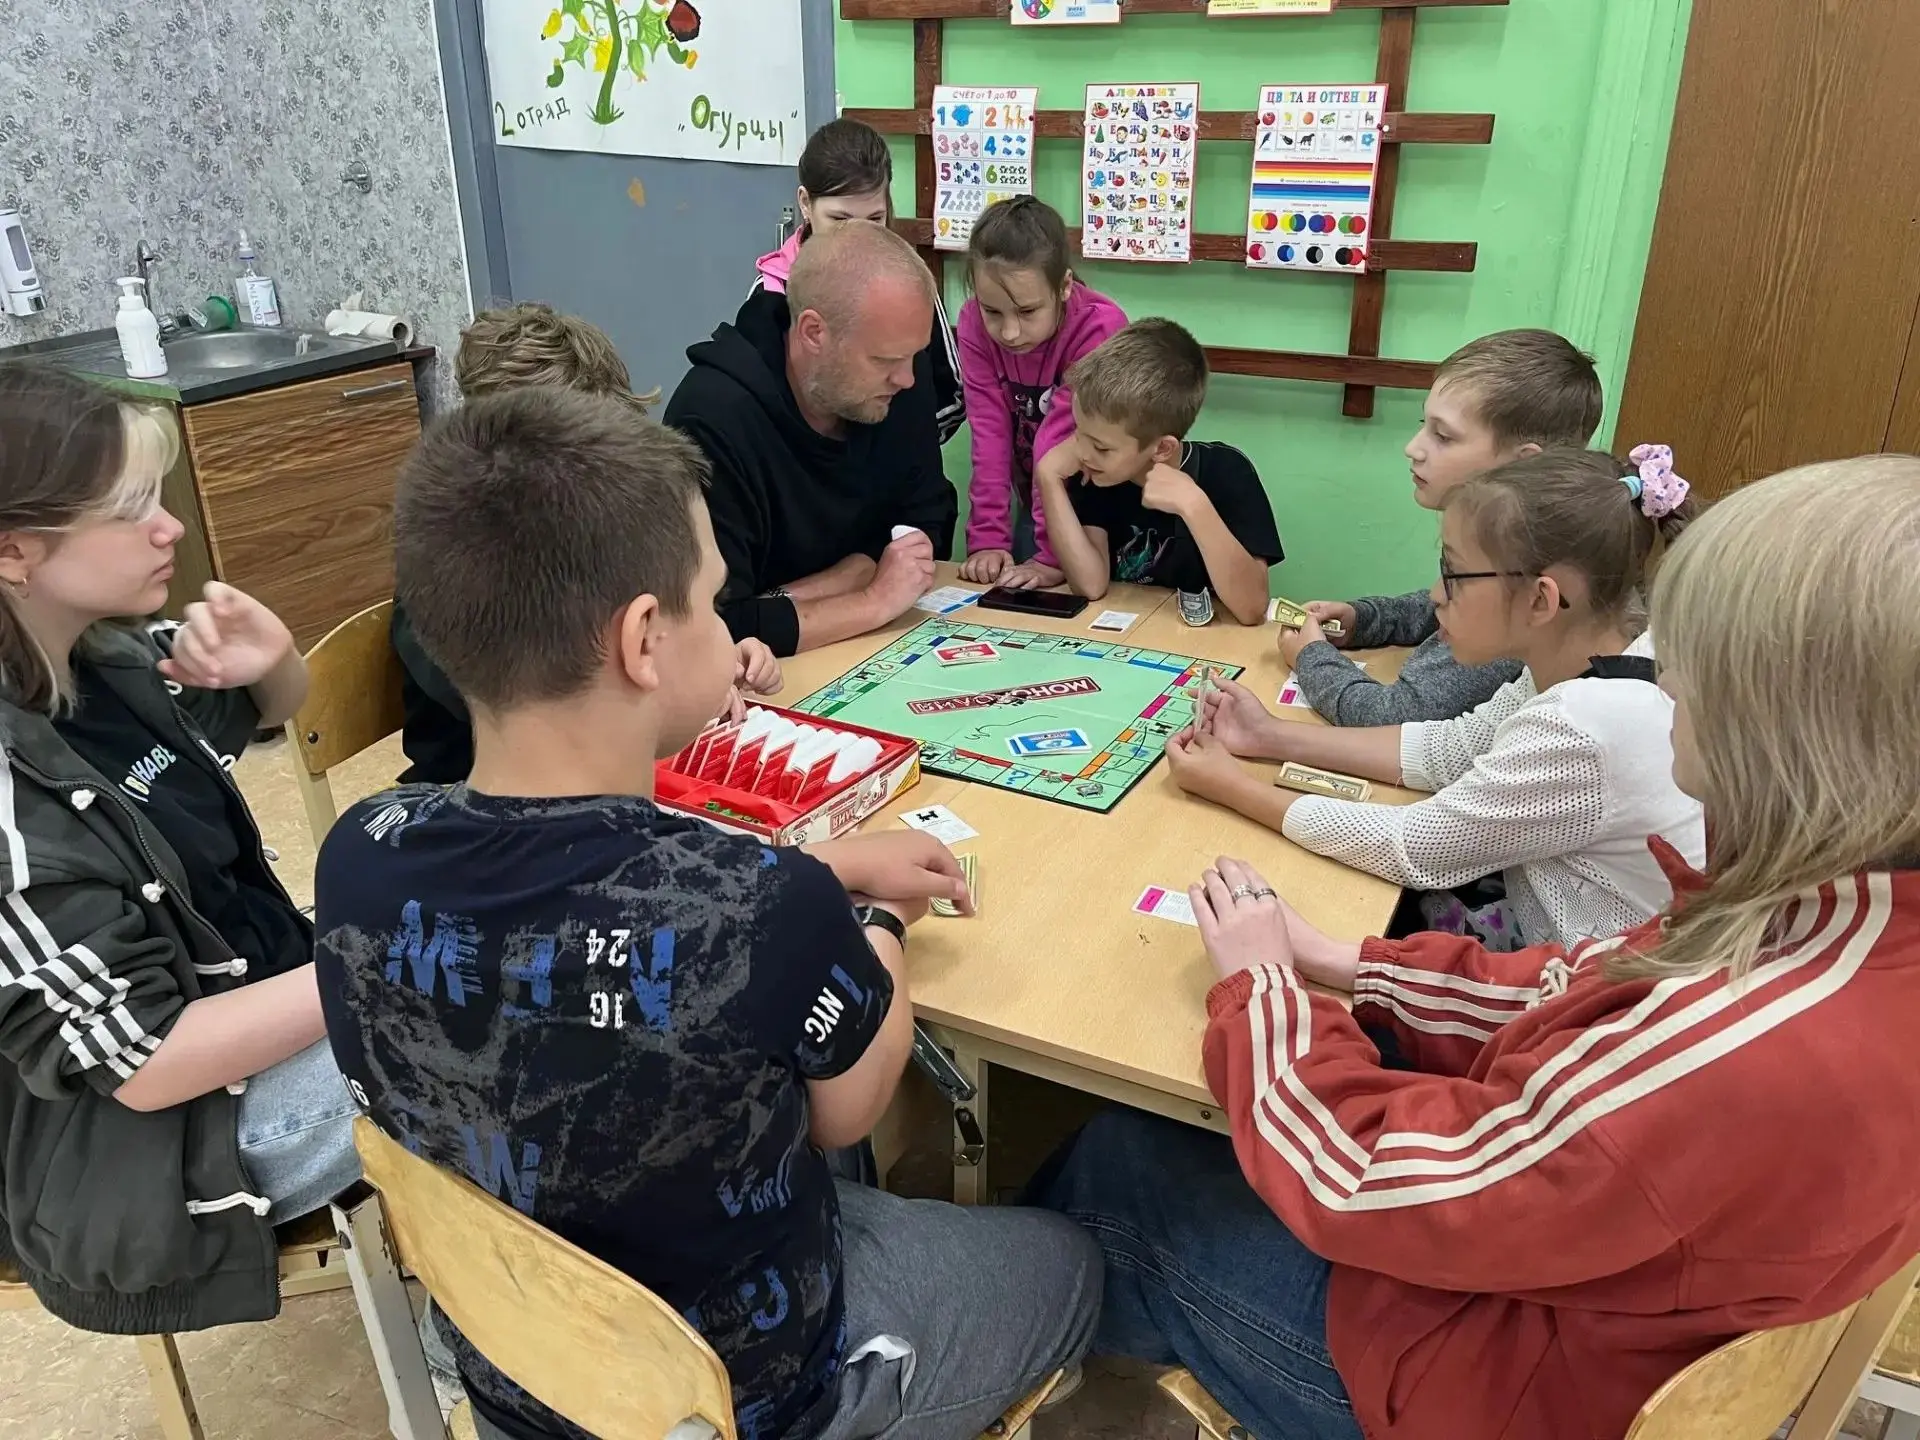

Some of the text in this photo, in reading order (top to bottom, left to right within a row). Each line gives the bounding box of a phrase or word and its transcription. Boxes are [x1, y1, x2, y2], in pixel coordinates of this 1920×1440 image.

[987, 90, 992, 99] 1
[1006, 90, 1017, 99] 10
[1306, 91, 1316, 103] И
[495, 97, 571, 137] 2 отряд
[937, 106, 997, 127] 1 2
[937, 134, 996, 156] 3 4
[940, 162, 998, 184] 5 6
[940, 190, 952, 209] 7
[938, 218, 950, 237] 9
[915, 679, 1090, 713] МОНООЛИЯ
[585, 928, 631, 968] 24
[804, 986, 845, 1043] NYC
